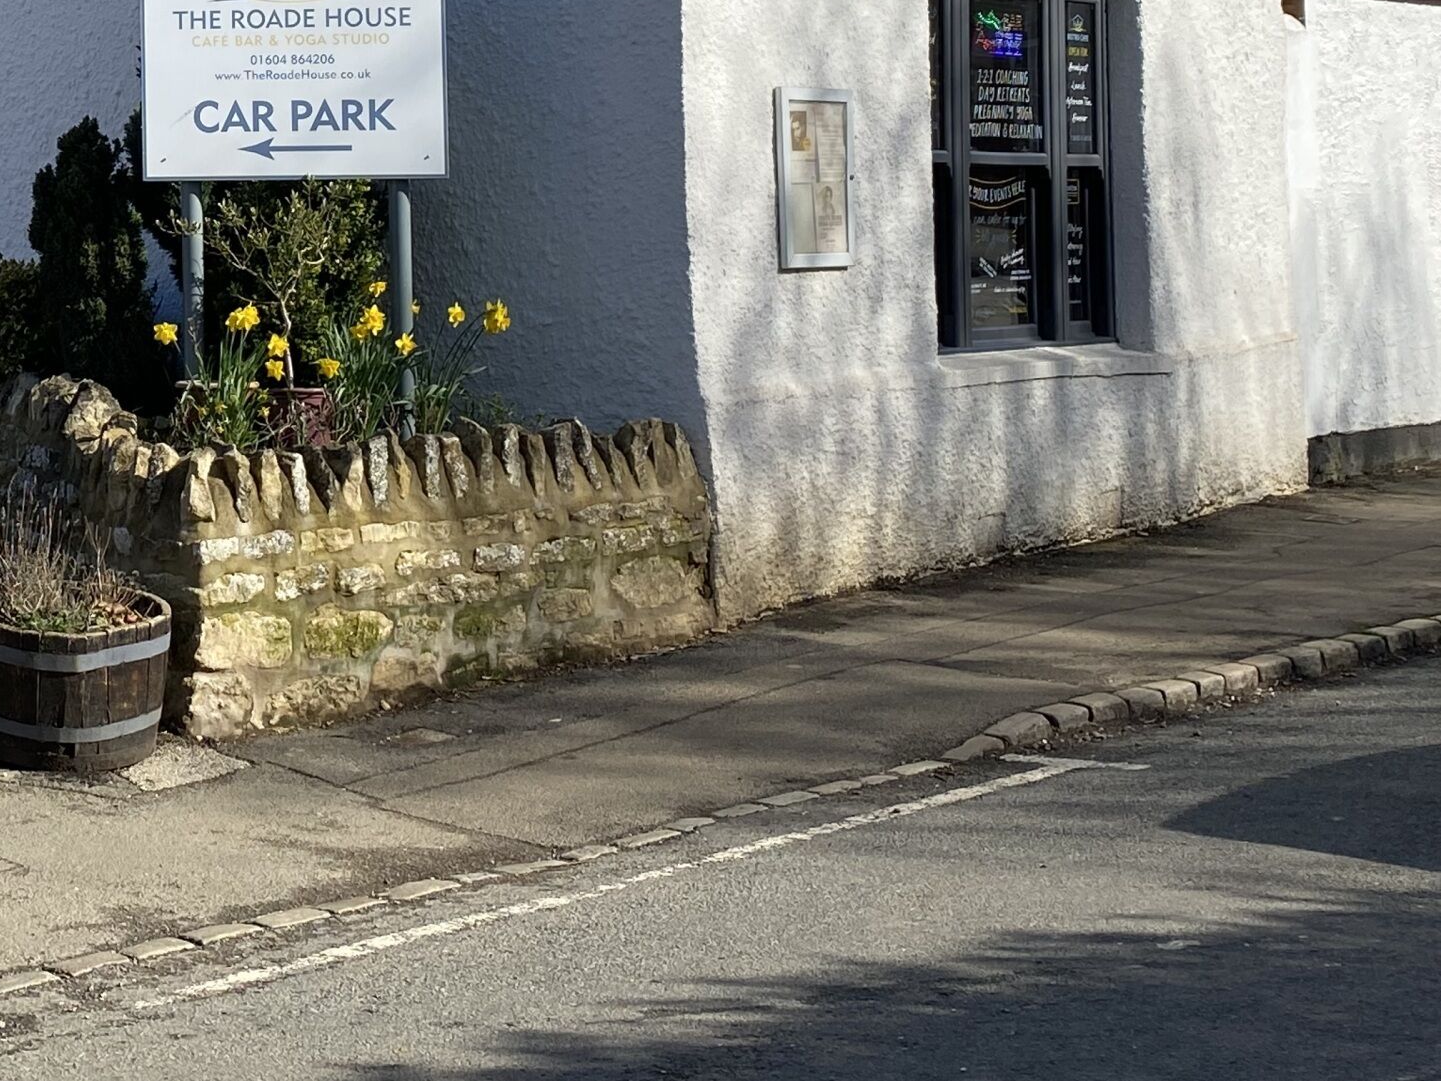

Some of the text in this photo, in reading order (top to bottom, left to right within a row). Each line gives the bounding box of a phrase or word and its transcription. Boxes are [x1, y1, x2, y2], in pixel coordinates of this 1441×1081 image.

[172, 6, 411, 30] THE ROADE HOUSE
[235, 34, 263, 47] BAR
[268, 34, 279, 47] &
[284, 33, 327, 46] YOGA
[332, 32, 390, 46] STUDIO
[250, 53, 335, 66] 01604 864206
[214, 68, 371, 81] www.TheRoadeHouse.co.uk
[995, 69, 1029, 86] COACHING
[977, 86, 1030, 103] DAY RETREATS
[193, 97, 397, 133] CAR PARK
[973, 104, 1014, 120] PREGNANCY
